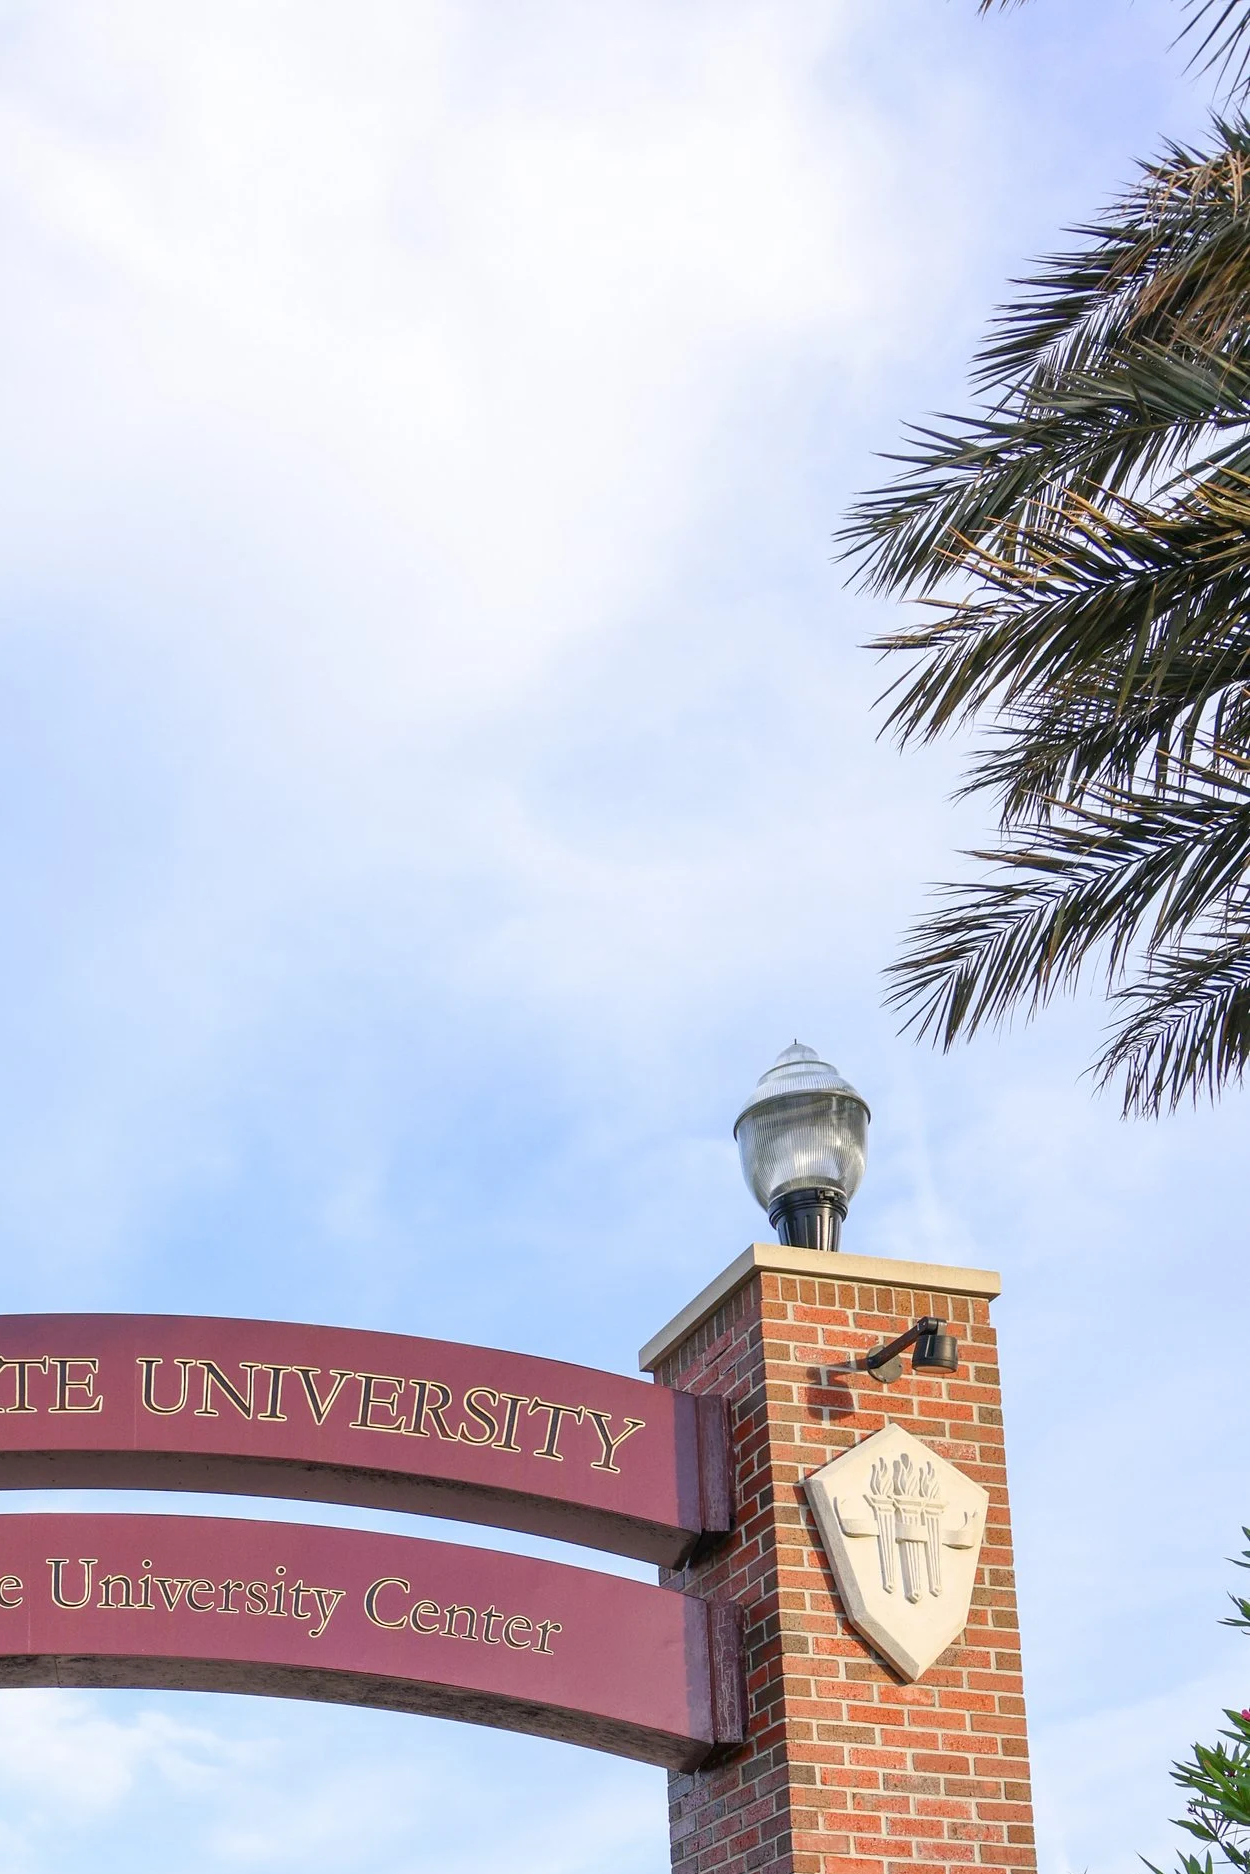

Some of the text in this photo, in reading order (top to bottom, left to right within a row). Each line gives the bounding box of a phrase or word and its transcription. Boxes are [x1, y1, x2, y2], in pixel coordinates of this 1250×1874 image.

[136, 1357, 646, 1475] UNIVERSITY
[46, 1558, 347, 1640] University
[363, 1577, 563, 1657] Center
